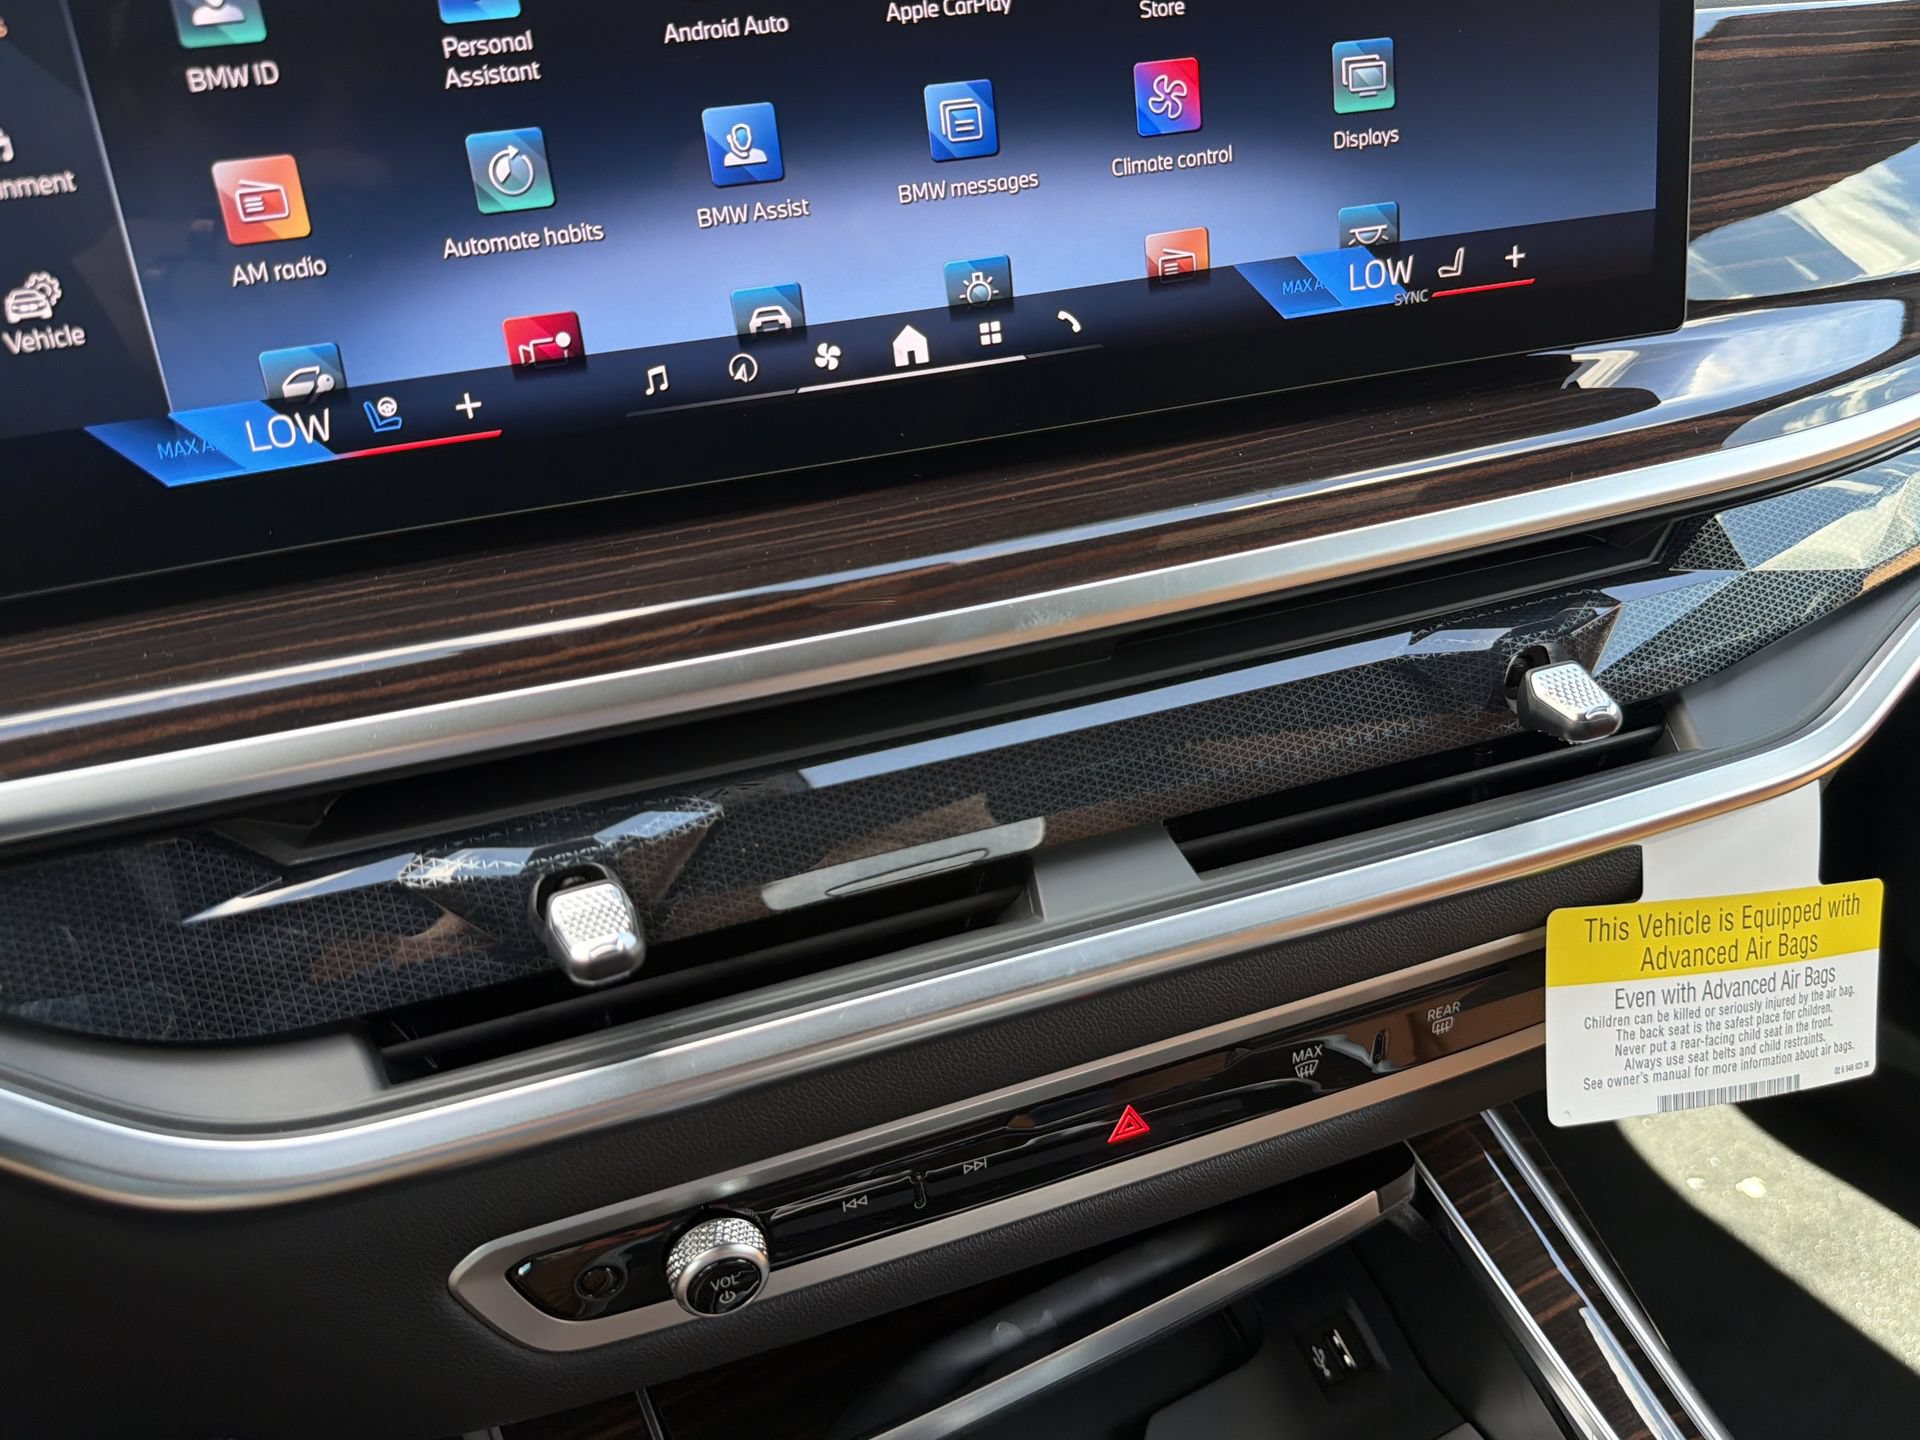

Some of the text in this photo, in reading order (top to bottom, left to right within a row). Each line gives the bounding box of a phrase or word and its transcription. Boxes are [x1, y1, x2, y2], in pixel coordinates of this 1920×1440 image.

[886, 0, 1012, 24] Apple CarPlay
[1139, 0, 1186, 19] Store
[441, 31, 535, 58] Personal
[664, 14, 790, 44] Android Auto
[185, 61, 280, 93] BMW ID
[444, 61, 542, 90] Assistant
[1333, 126, 1400, 150] Displays
[1111, 145, 1234, 178] Climate control
[897, 171, 1039, 204] BMW messages
[696, 197, 811, 229] BMW Assist
[443, 222, 606, 260] Automate habits
[231, 257, 328, 288] AM radio
[1282, 278, 1312, 295] MAX
[1349, 254, 1415, 292] LOW
[1393, 288, 1430, 306] SYNC
[2, 324, 87, 356] Vehicle
[244, 407, 332, 453] LOW
[157, 438, 200, 461] MAX
[1585, 893, 1860, 942] This Vehicle is Equipped with
[1641, 933, 1818, 972] Advanced Air Bags
[1615, 967, 1836, 1010] Even with Advanced Air Bags
[1427, 1002, 1460, 1021] REAR
[1584, 985, 1856, 1031] Children can be killed or seriously injured by the air bag.
[1616, 1003, 1833, 1042] The back seat is the safest place for children.
[1615, 1017, 1833, 1058] Never put a rear-facing child seat in the front.
[1625, 1032, 1825, 1072] Always use seat belts and child restraints.
[1292, 1044, 1323, 1064] MAX
[1584, 1039, 1854, 1092] See owner's manual for more information about air bags.
[710, 1274, 740, 1291] VOL
